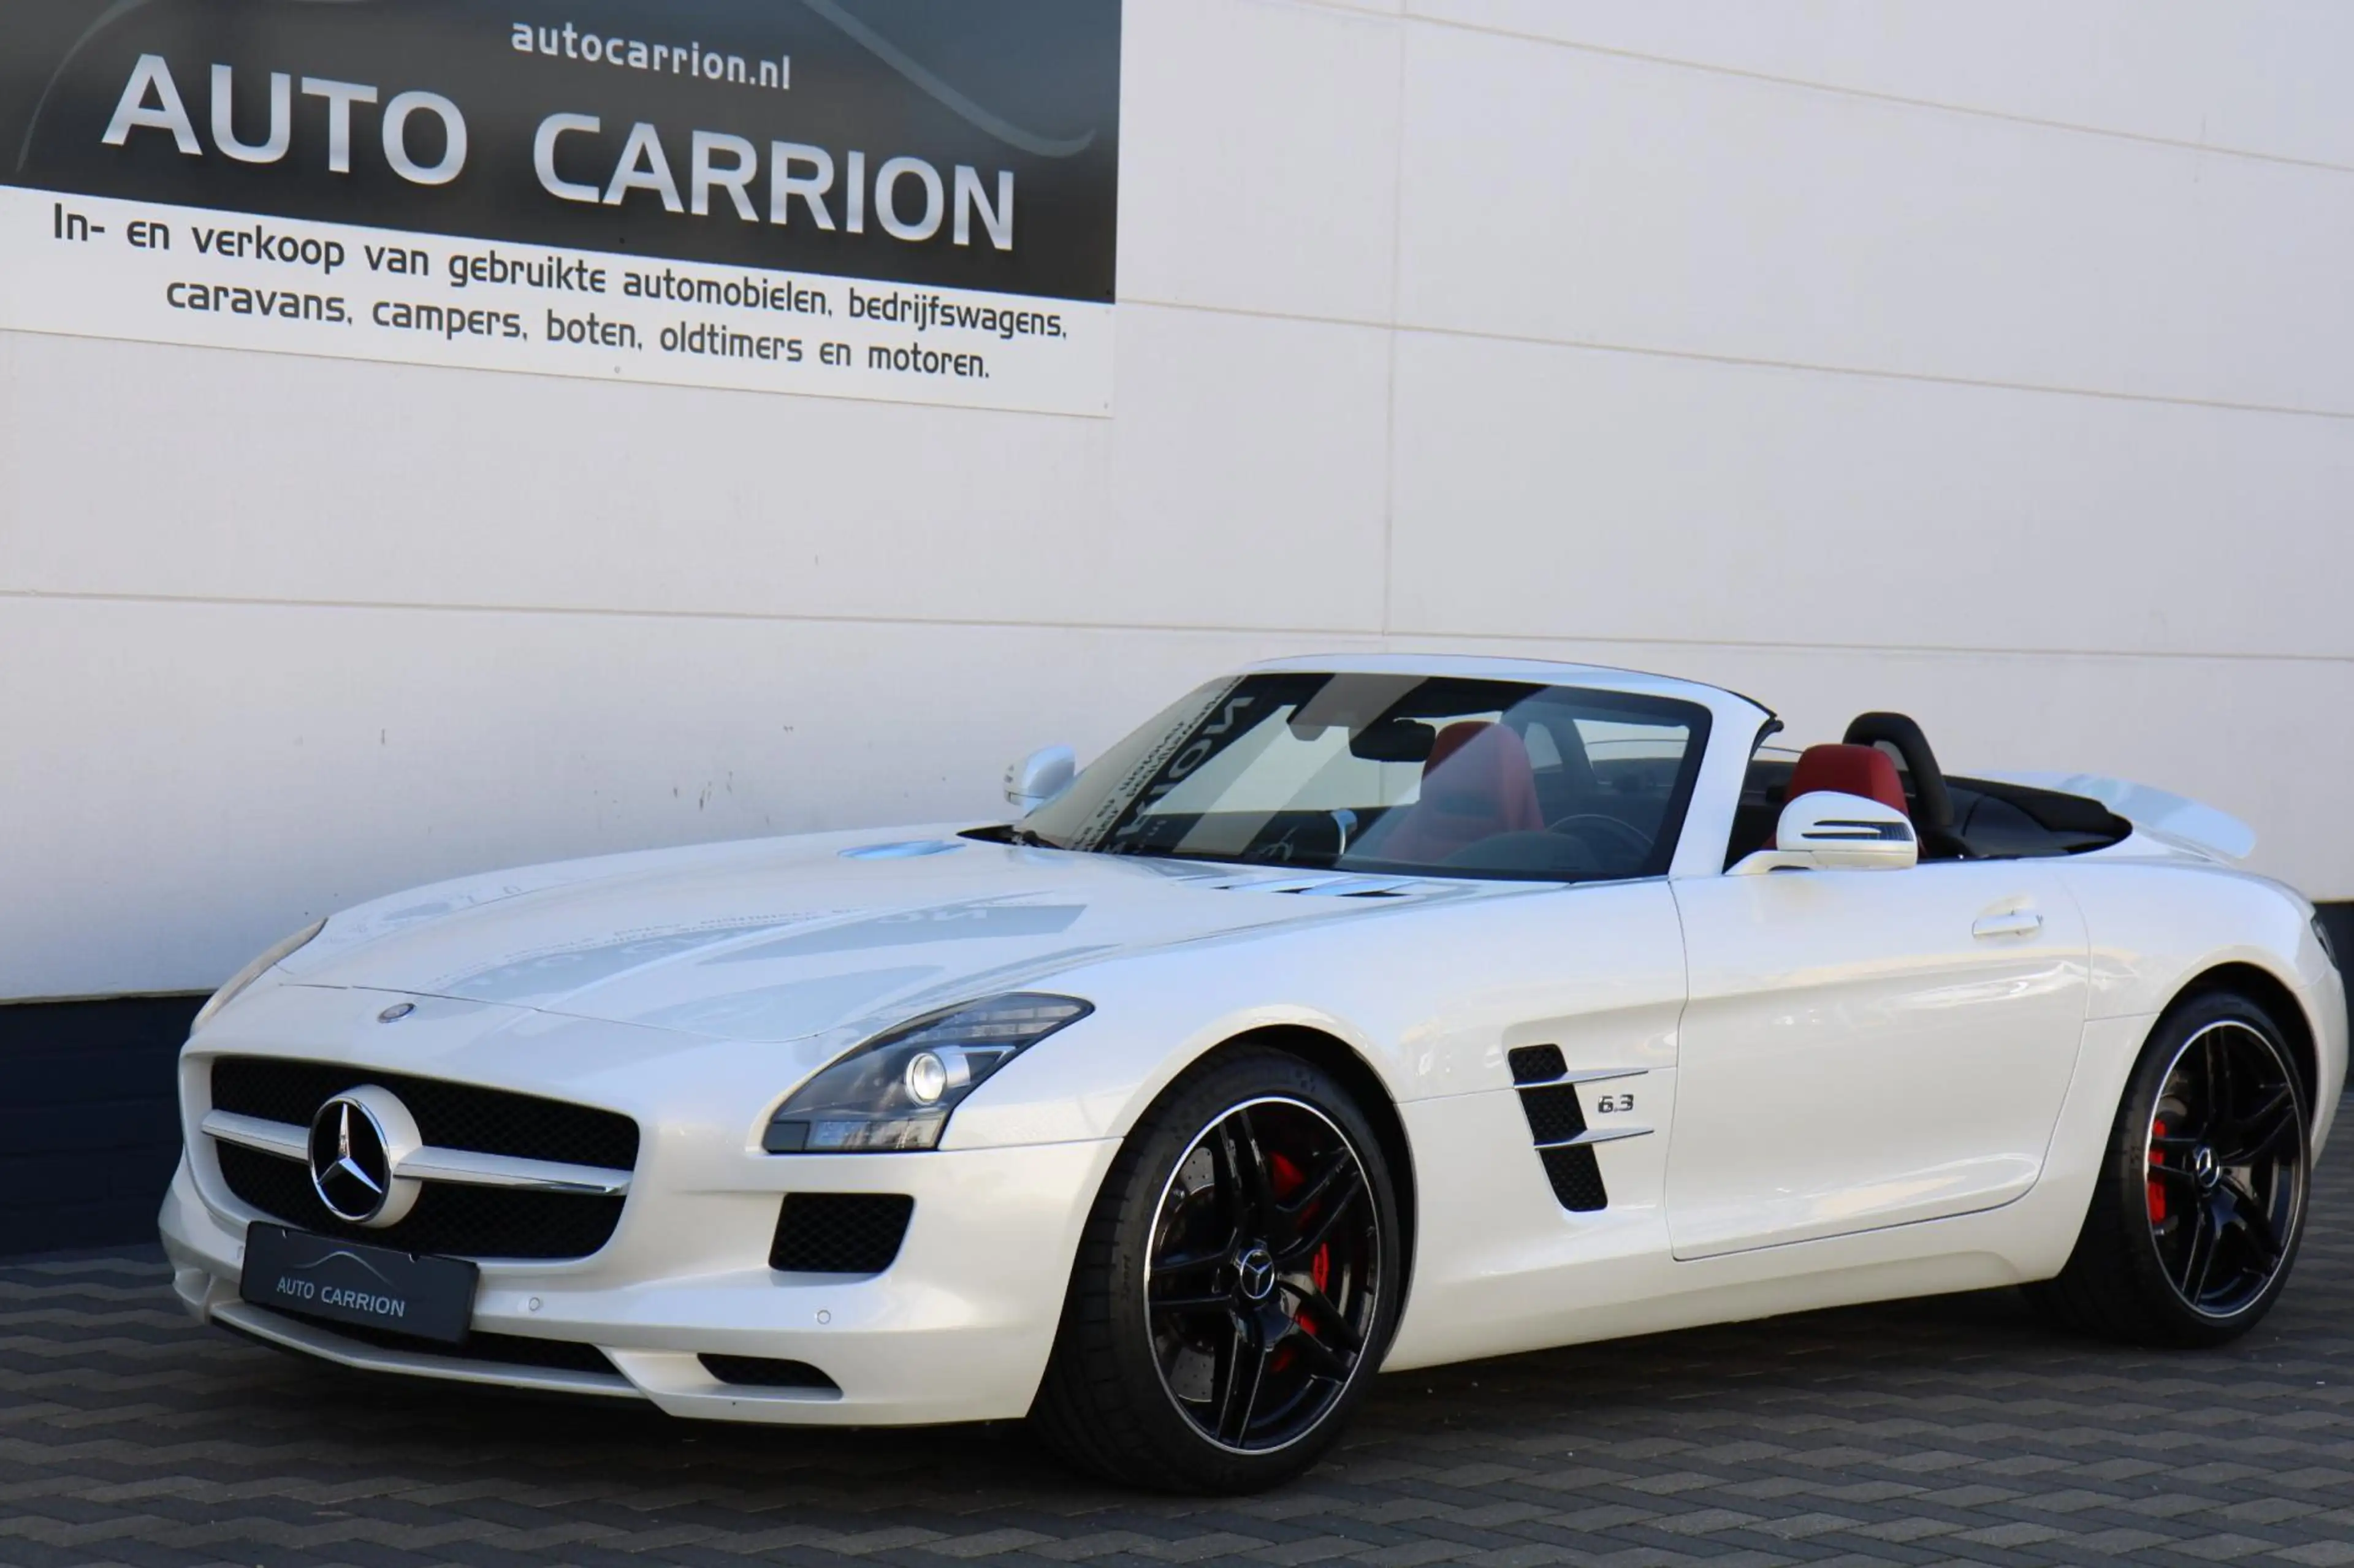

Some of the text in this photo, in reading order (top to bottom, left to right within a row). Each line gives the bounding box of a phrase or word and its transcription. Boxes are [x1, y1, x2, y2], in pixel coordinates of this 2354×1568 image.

[511, 22, 790, 90] autocarrion.nl
[101, 54, 1014, 251] AUTO CARRION
[55, 202, 1067, 340] In- en verkoop van gebruikte automobielen, bedrijfswagens,
[167, 282, 989, 378] caravans, campers, boten, oldtimers en motoren.
[1598, 1094, 1634, 1114] 6.3
[276, 1276, 405, 1318] AUTO CARRION
